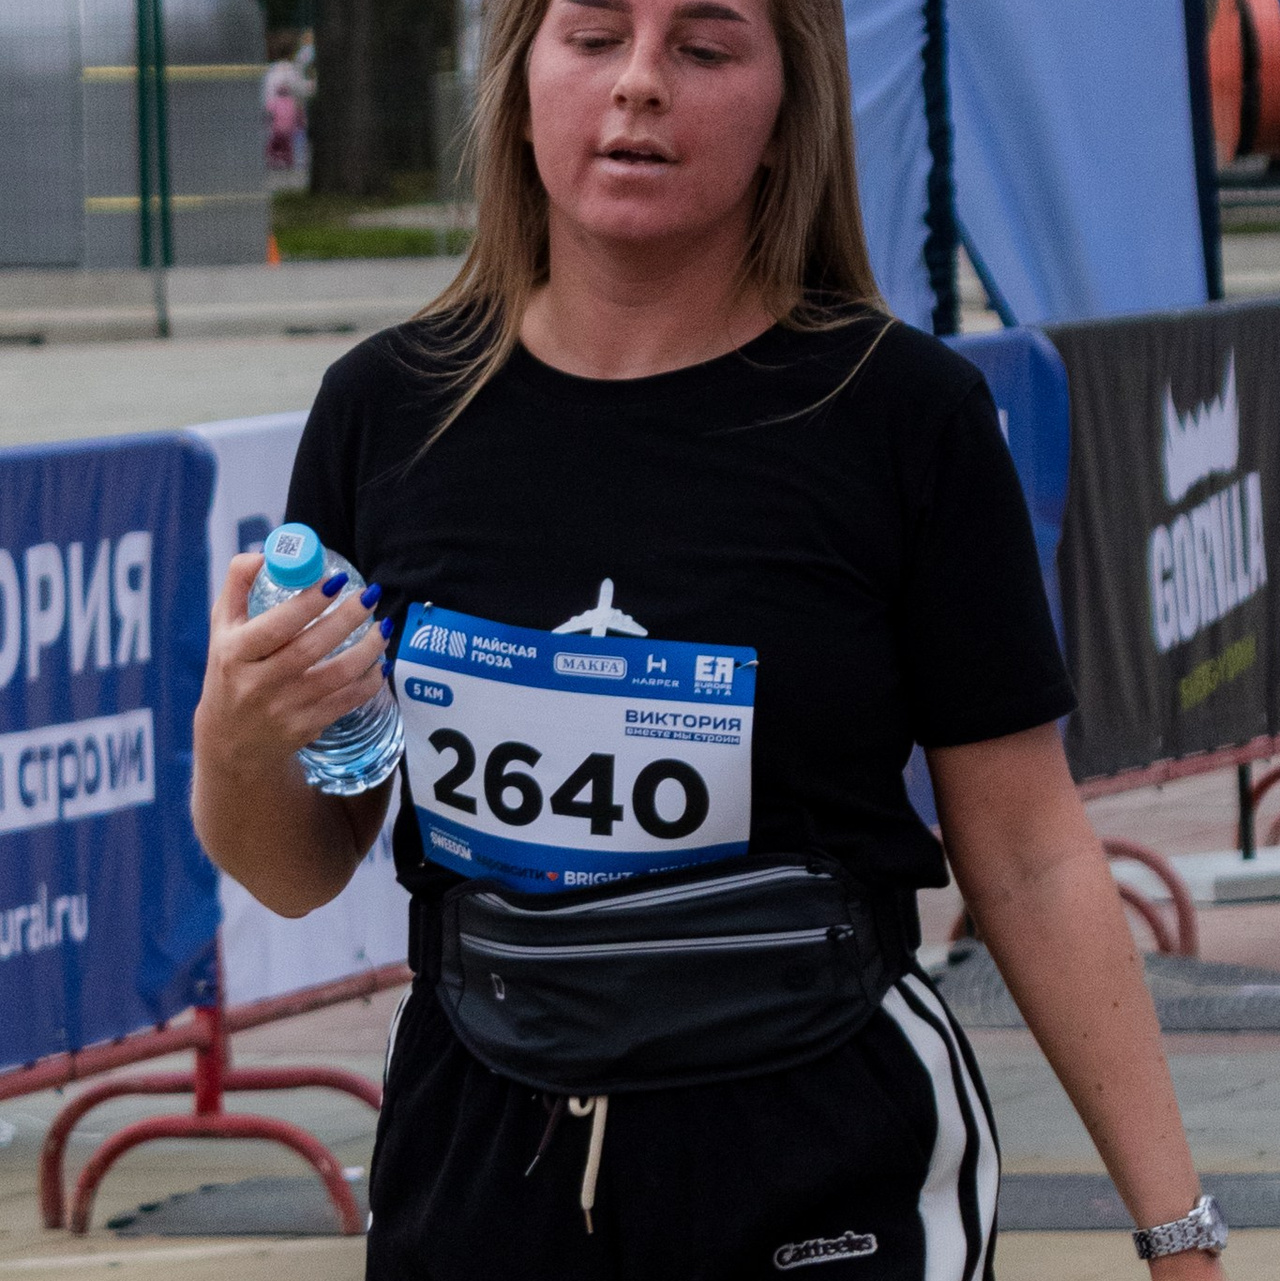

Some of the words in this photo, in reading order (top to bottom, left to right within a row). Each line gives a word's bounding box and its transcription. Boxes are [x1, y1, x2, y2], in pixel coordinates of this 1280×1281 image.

[1151, 471, 1268, 654] GORILLA
[472, 636, 537, 659] МАЙСКАЯ
[471, 649, 512, 669] ГРОЗА
[562, 657, 620, 674] MAKFA
[413, 684, 421, 696] 5
[631, 677, 680, 688] HARPER
[694, 689, 732, 697] ASIA
[625, 709, 742, 732] ВИКТОРИЯ
[626, 727, 671, 739] вместе
[673, 731, 691, 740] мы
[694, 734, 740, 745] строим
[428, 728, 710, 840] 2640
